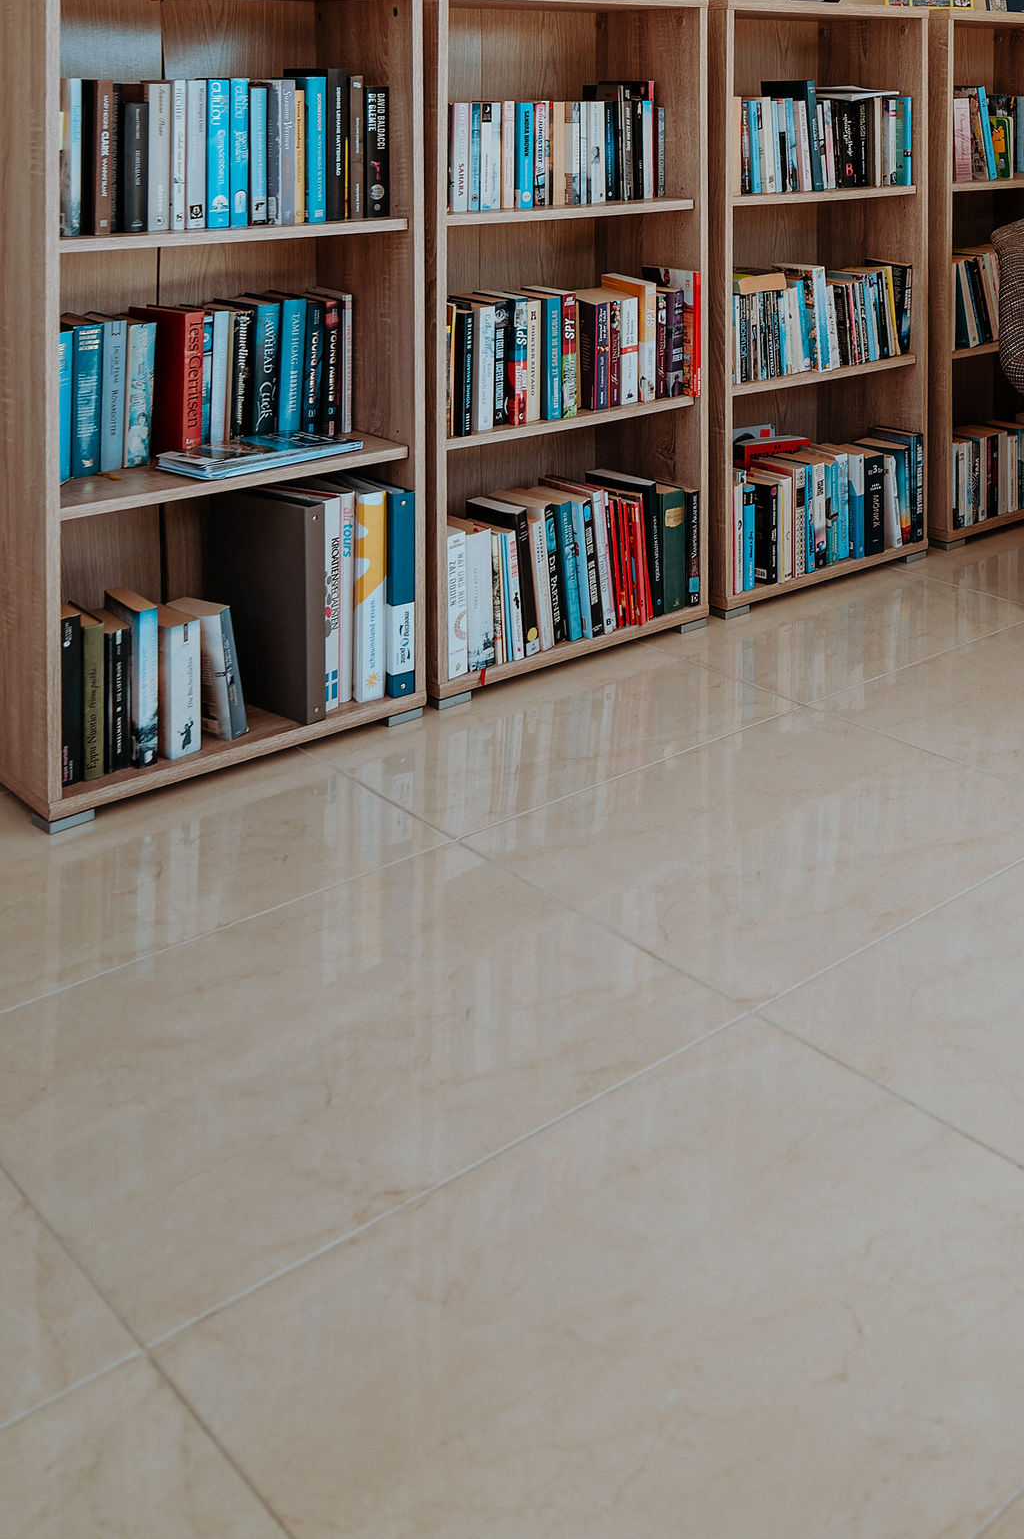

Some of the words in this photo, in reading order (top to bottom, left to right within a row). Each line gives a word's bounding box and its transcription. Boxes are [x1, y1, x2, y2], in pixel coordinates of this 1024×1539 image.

[210, 82, 221, 125] GUILLOU
[235, 86, 244, 119] GUILLOU
[283, 89, 292, 120] Suzanne
[368, 93, 376, 103] DE
[377, 93, 385, 114] DAVID
[368, 104, 376, 131] GLEMTE
[101, 131, 109, 156] CLARK
[283, 121, 292, 150] Vermeer
[377, 115, 385, 150] BALDACCI
[845, 162, 854, 177] B
[292, 312, 300, 335] TAMI
[564, 318, 575, 339] SPY
[646, 309, 655, 327] SPY
[189, 318, 203, 351] Tess
[262, 312, 275, 373] LAWHEAD
[311, 331, 319, 366] YOUNG
[329, 329, 337, 364] YOUNG
[516, 326, 526, 345] SPY
[290, 337, 298, 364] HOAG
[187, 355, 202, 429] Gerritsen
[309, 368, 318, 404] AGENTS
[328, 366, 337, 402] AGENTS
[872, 464, 878, 474] 3
[871, 494, 880, 528] MÖNKÄ
[343, 507, 353, 557] airtours
[457, 553, 465, 571] WAT
[549, 555, 556, 573] DE
[588, 560, 595, 569] DE
[551, 575, 560, 625] PARTNER
[403, 611, 411, 637] meeting
[368, 622, 377, 669] schauinsland
[399, 647, 407, 664] point
[87, 714, 96, 744] Nuotio
[87, 746, 98, 770] Eppu
